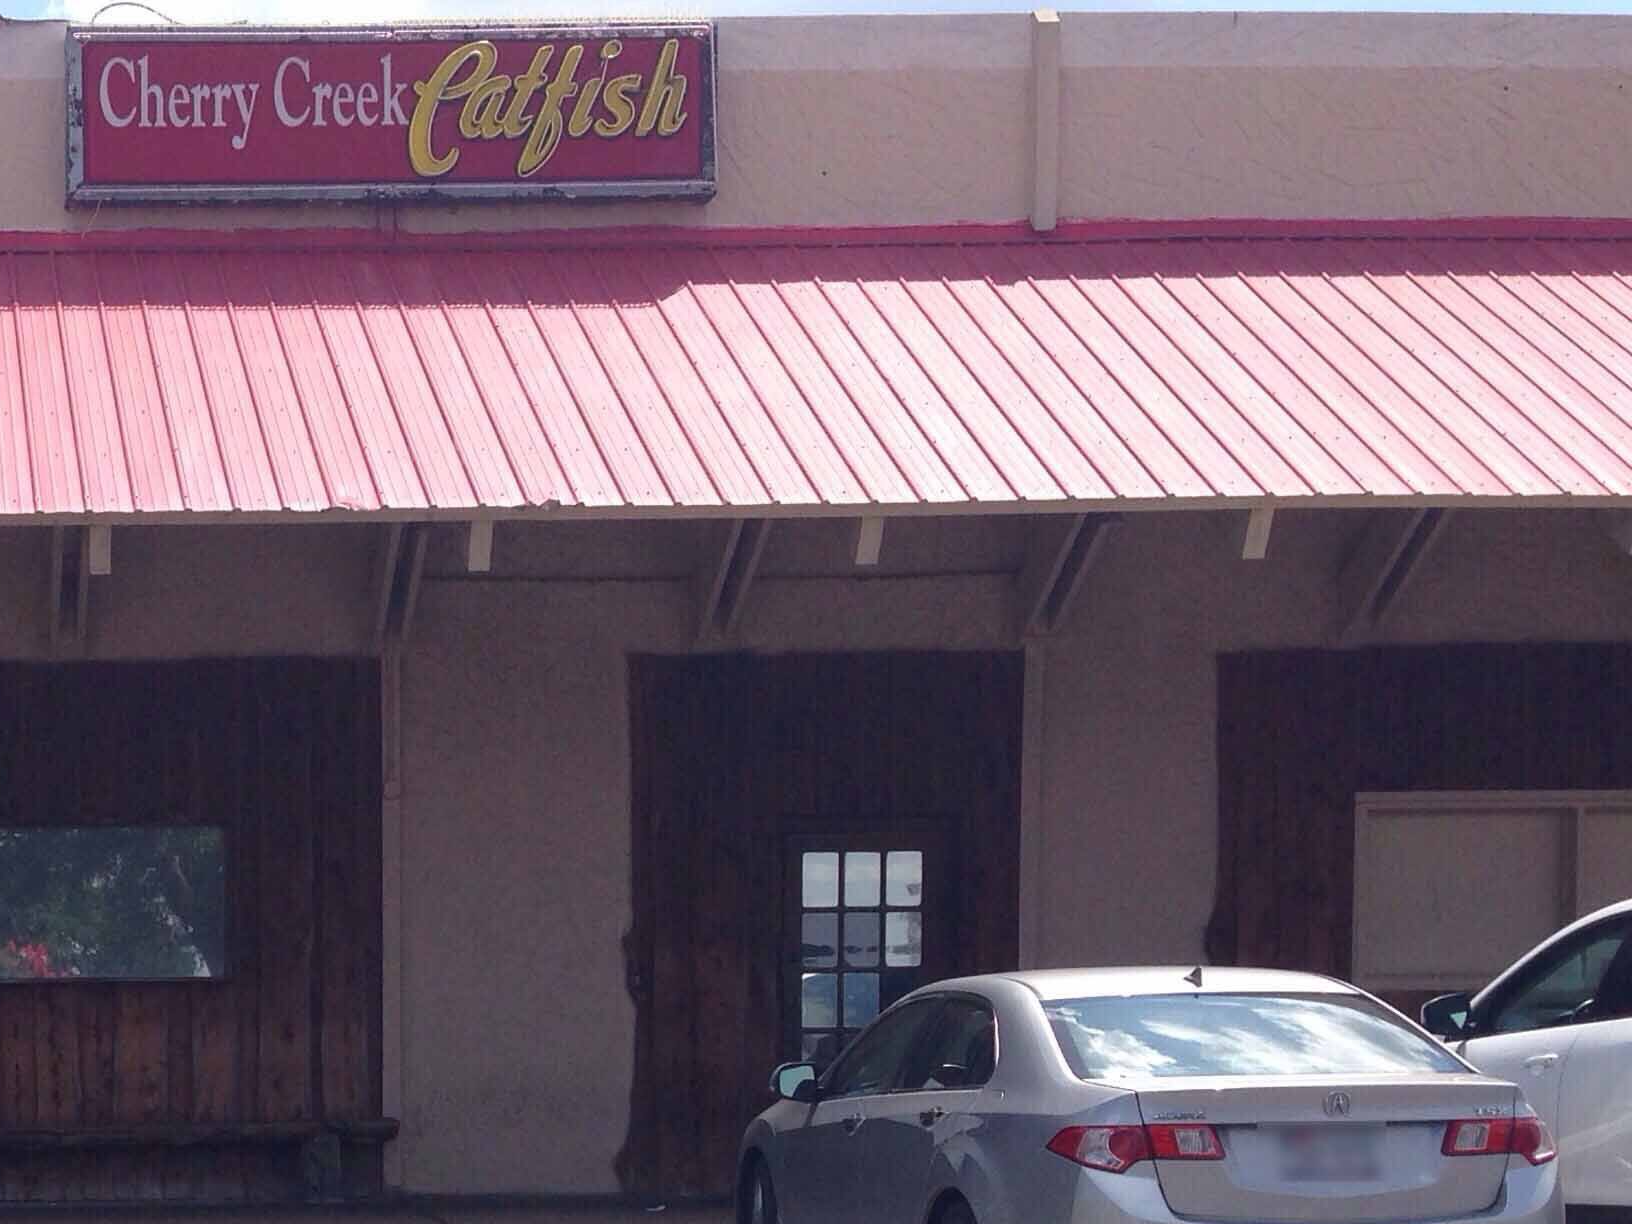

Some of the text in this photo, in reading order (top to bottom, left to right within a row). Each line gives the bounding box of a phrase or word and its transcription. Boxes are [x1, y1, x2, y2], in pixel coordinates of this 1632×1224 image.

[99, 39, 688, 178] Cherry Creek Catfish
